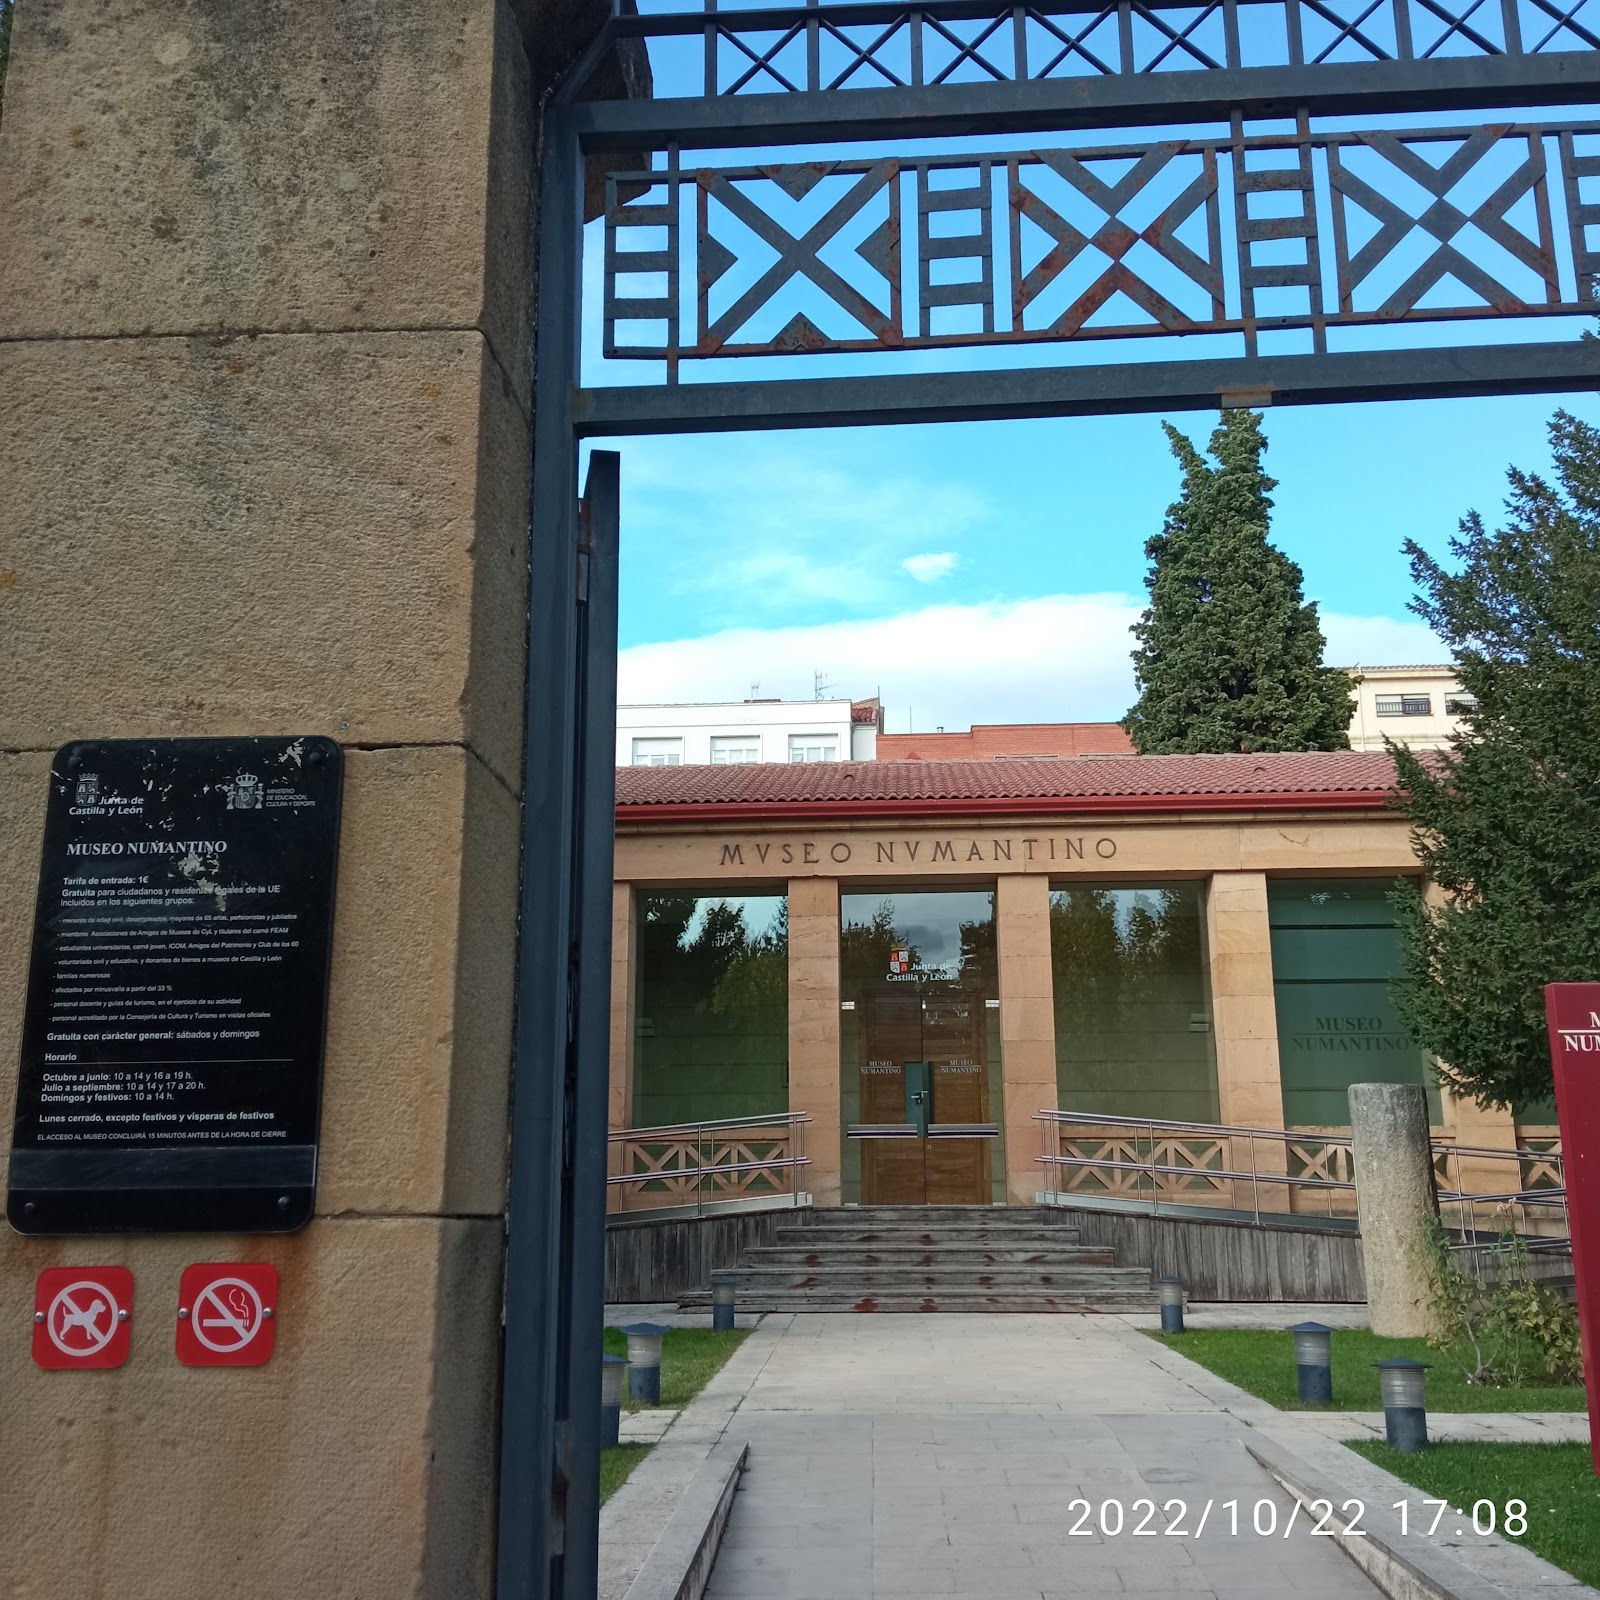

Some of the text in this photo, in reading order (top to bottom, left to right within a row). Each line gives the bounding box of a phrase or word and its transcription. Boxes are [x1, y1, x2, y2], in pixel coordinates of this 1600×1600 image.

[98, 796, 144, 805] Junta de
[69, 805, 143, 817] Castilla y León
[66, 840, 228, 856] MUSEO NUMANTINO
[719, 837, 1117, 866] MVSEO NVMANTINO
[63, 875, 149, 885] Tarifa de entrada: 1€
[62, 887, 96, 896] Gratuita
[97, 889, 116, 898] para
[117, 886, 163, 895] ciudadanos
[164, 888, 171, 897] y
[245, 884, 256, 893] de
[258, 884, 266, 893] la
[267, 884, 281, 893] UE
[60, 897, 95, 906] incluidos
[109, 897, 121, 905] los
[122, 896, 163, 907] siguientes
[164, 897, 195, 906] grupos:
[910, 962, 936, 971] Junta
[886, 972, 952, 983] Castilla y León
[1315, 1017, 1382, 1031] MUSEO
[46, 1032, 81, 1041] Gratuita
[101, 1031, 137, 1040] carácter
[138, 1030, 174, 1041] general:
[176, 1030, 211, 1038] sábados
[212, 1031, 219, 1040] y
[220, 1029, 260, 1040] domingos
[1292, 1036, 1410, 1052] NUMANTINO
[44, 1052, 77, 1061] Horario
[43, 1073, 78, 1081] Octubre
[86, 1072, 112, 1083] junio:
[113, 1072, 124, 1080] 10
[134, 1072, 144, 1080] 14
[145, 1073, 151, 1082] y
[153, 1071, 164, 1080] 16
[173, 1071, 184, 1079] 19
[185, 1071, 193, 1079] h.
[41, 1083, 63, 1092] Julio
[72, 1082, 124, 1093] septiembre:
[126, 1082, 137, 1090] 10
[146, 1082, 157, 1090] 14
[158, 1083, 164, 1092] y
[166, 1081, 176, 1090] 17
[185, 1081, 197, 1089] 20
[198, 1081, 206, 1089] h.
[41, 1093, 85, 1104] Domingos
[86, 1095, 93, 1103] y
[94, 1092, 132, 1101] festivos:
[134, 1092, 144, 1100] 10
[154, 1092, 164, 1100] 14
[166, 1092, 175, 1100] h.
[39, 1111, 275, 1124] Lunes cerrado, excepto festivos y vísperas de festivos
[108, 1132, 147, 1140] CONCLUIRÁ
